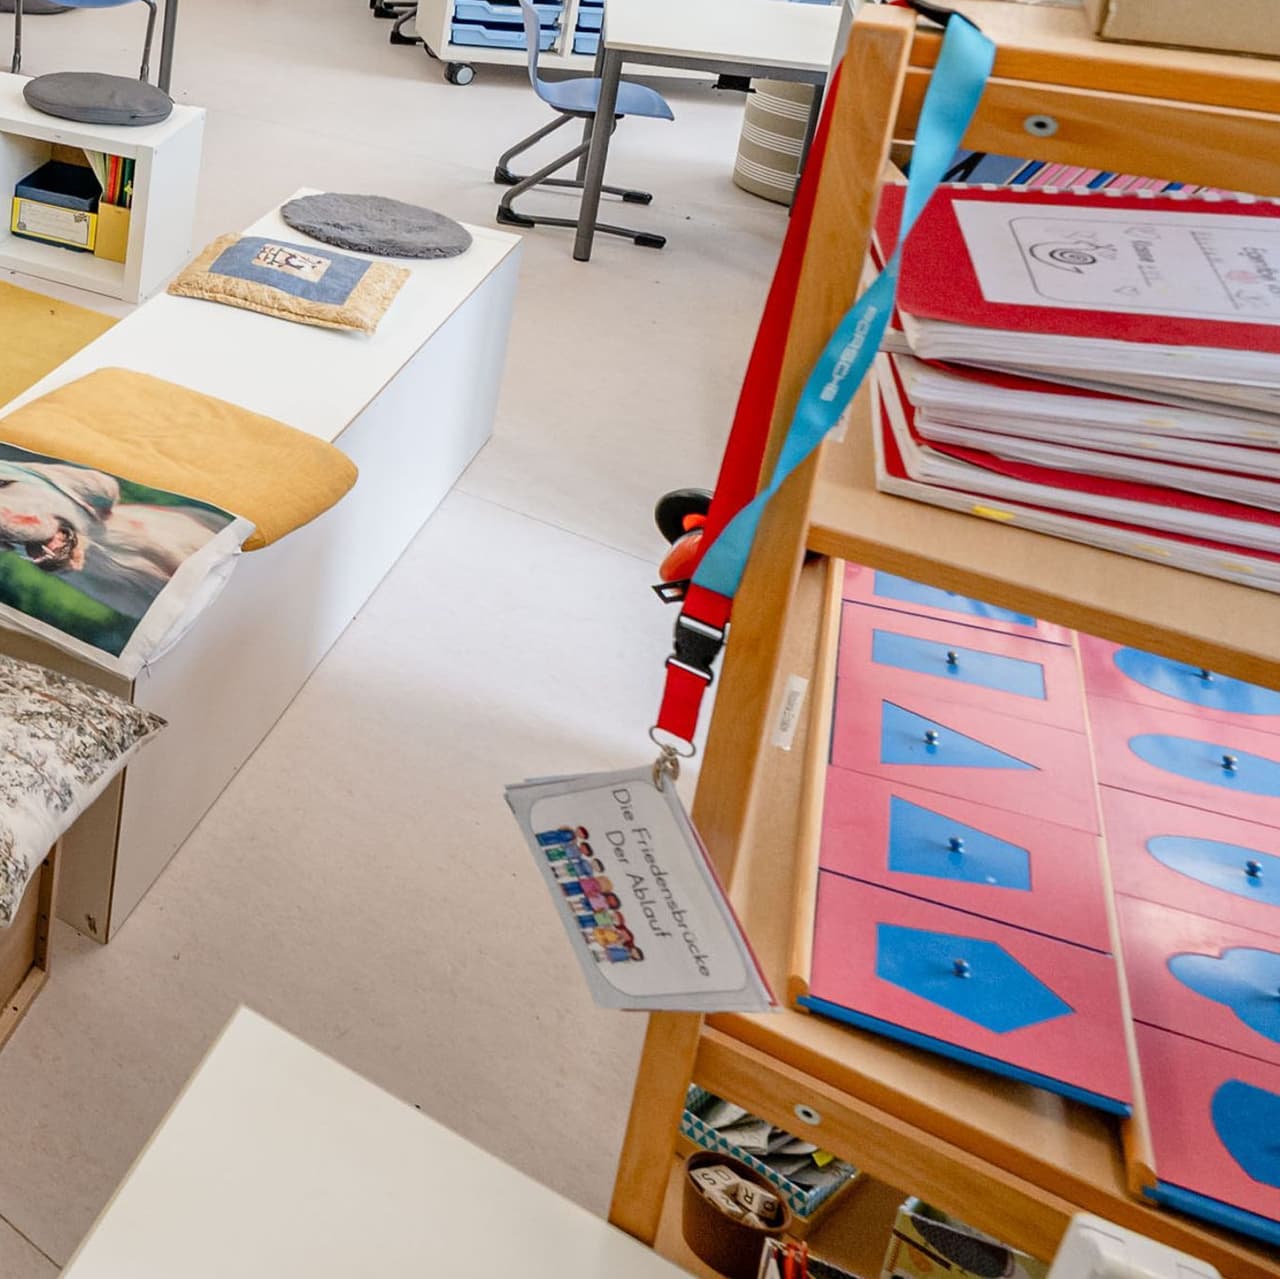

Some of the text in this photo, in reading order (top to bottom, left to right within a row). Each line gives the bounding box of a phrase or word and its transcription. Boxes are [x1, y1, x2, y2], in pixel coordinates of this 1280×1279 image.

[605, 829, 672, 939] Der Ablauf
[612, 787, 711, 978] Die Friedensbrücke
